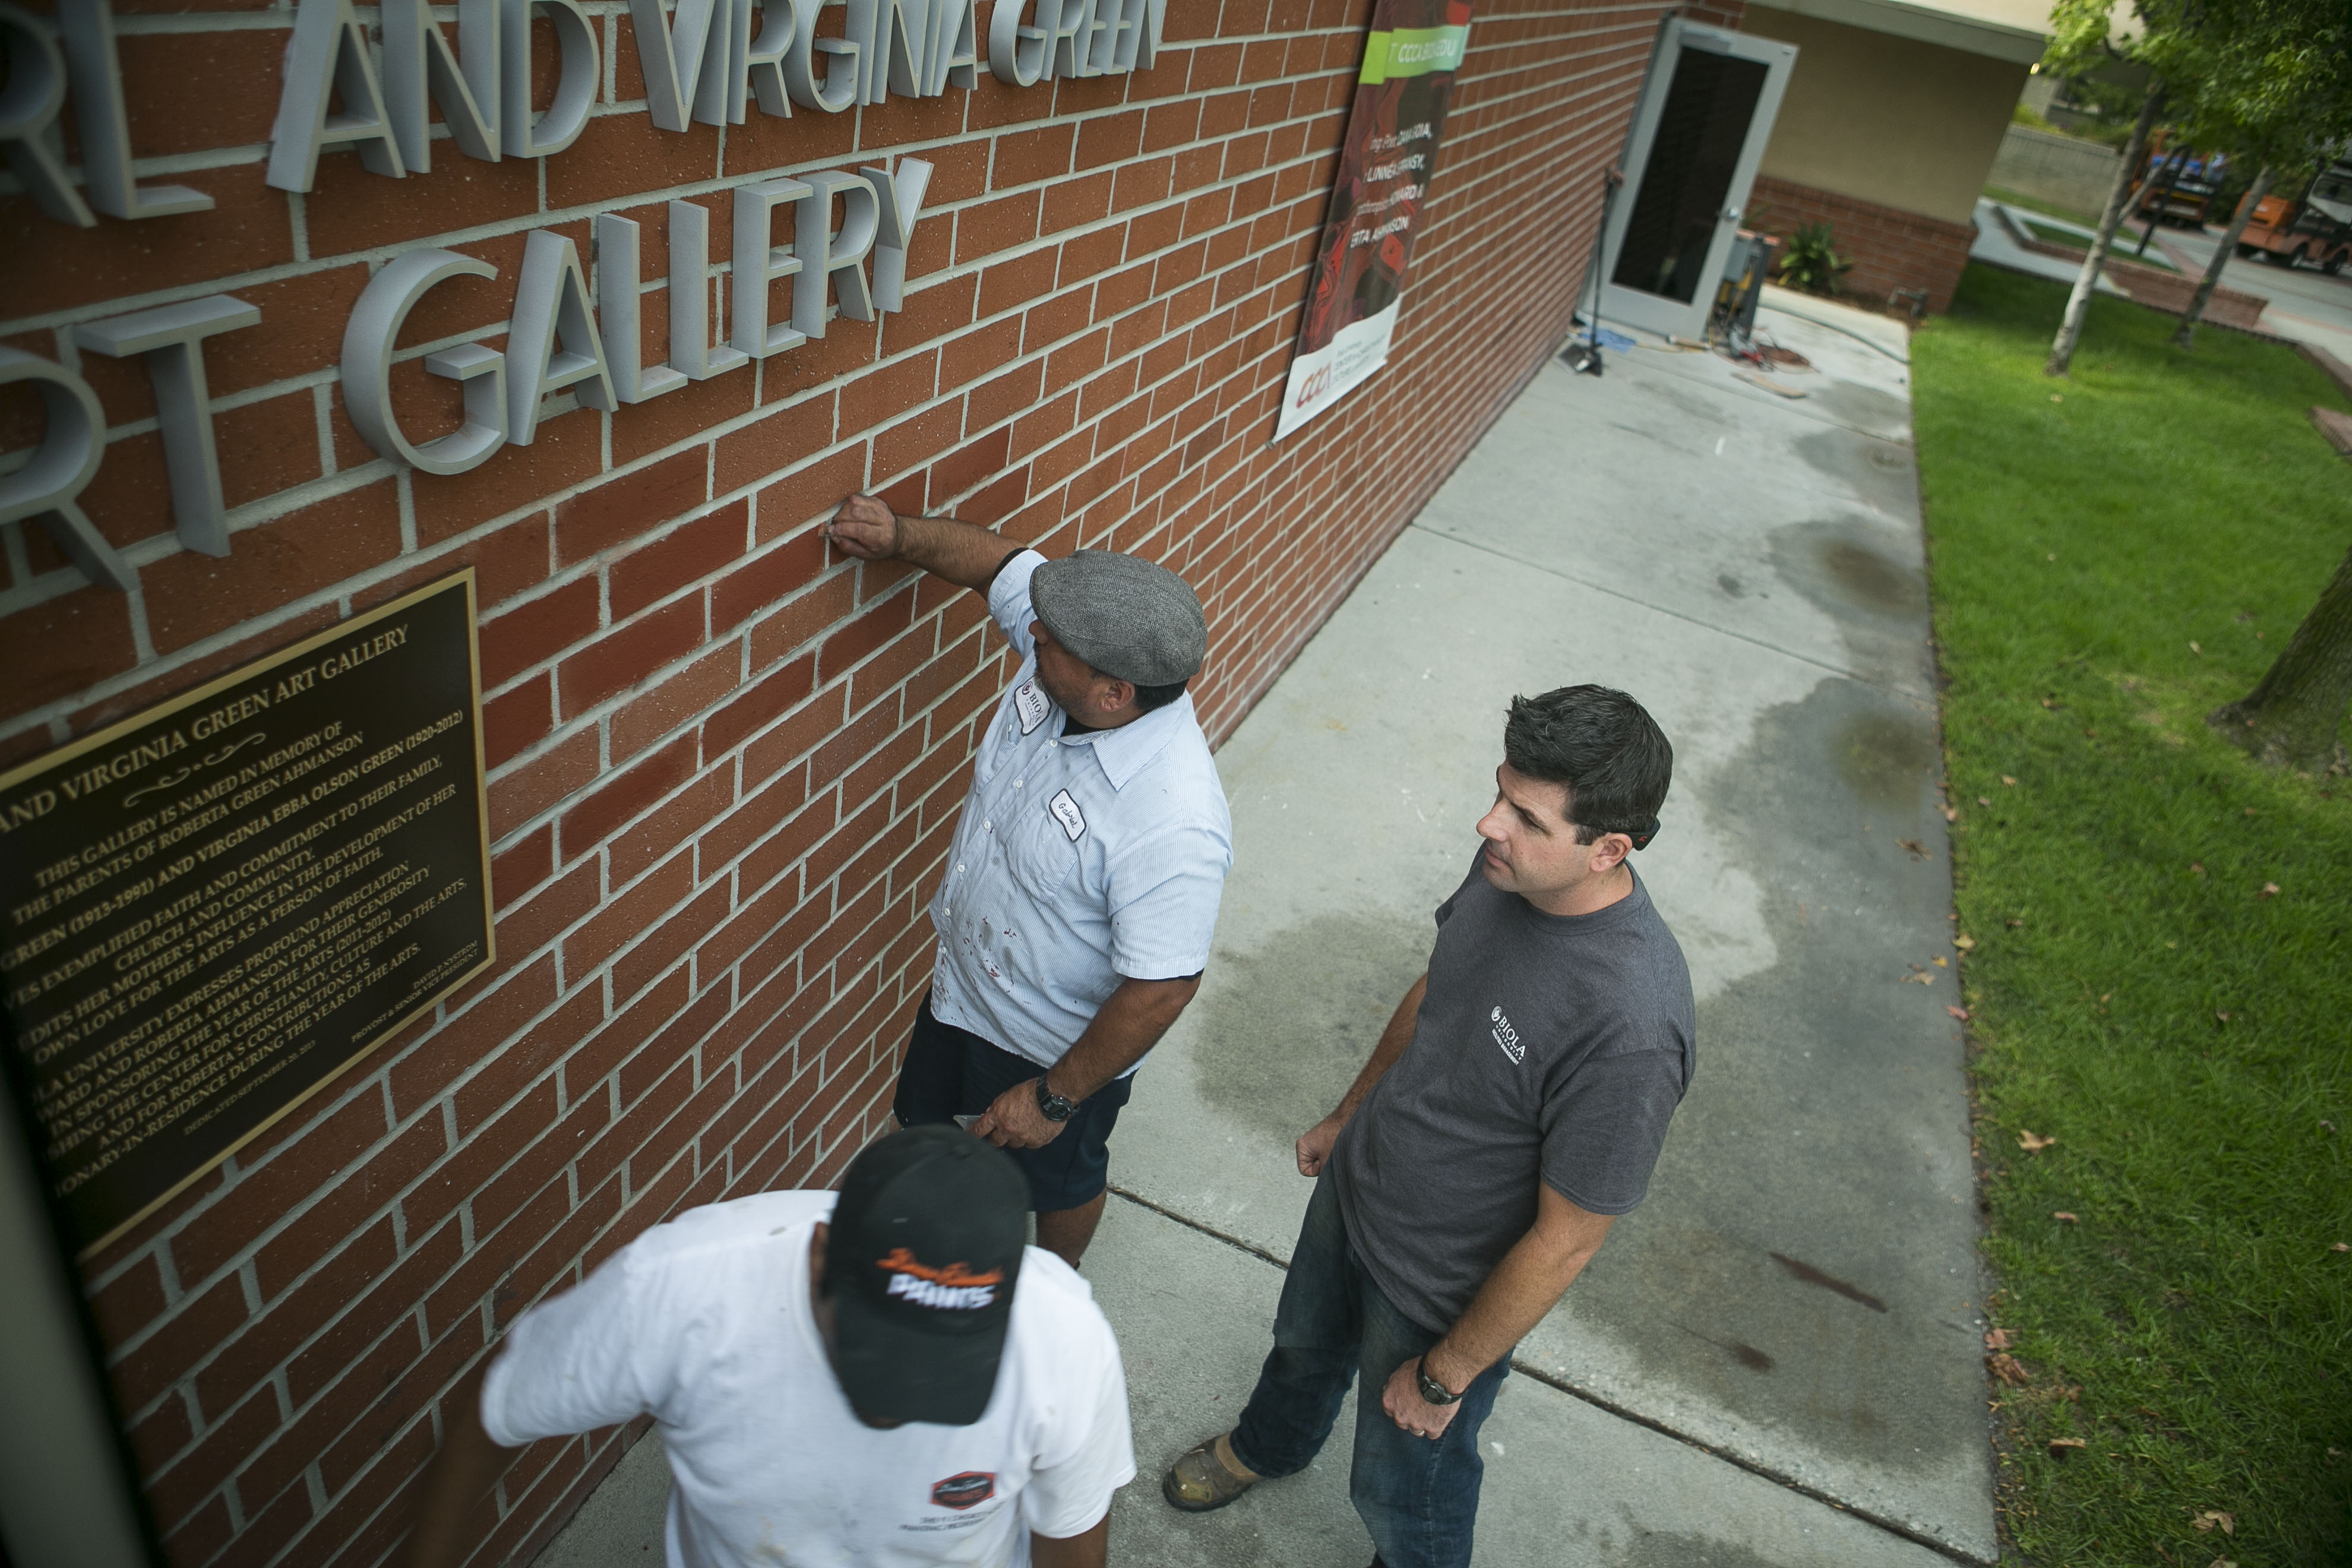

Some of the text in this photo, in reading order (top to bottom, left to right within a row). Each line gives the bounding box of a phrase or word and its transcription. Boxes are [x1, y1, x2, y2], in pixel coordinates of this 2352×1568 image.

[265, 0, 599, 193] AND
[629, 0, 978, 132] VIRGINIA
[988, 0, 1164, 87] GREEN
[342, 157, 934, 475] GALLERY
[0, 624, 407, 832] AND VIRGINIA GREEN ART GALLERY
[13, 731, 363, 924] THE PARENTS OF ROBERTA GREEN AHMANSON
[36, 721, 342, 887] THIS GALLERY IS NAMED IN MEMORY OF
[0, 710, 463, 972] GREEN (1913-1991) AND VIRGINIA EBBA OLSON GREEN (1920-2012)
[43, 919, 151, 990] EXEMPLIFIED
[154, 890, 201, 927] FAITH
[206, 871, 238, 899] AND
[240, 813, 337, 877] COMMITMENT
[339, 802, 358, 821] TO
[359, 780, 397, 810] THEIR
[398, 755, 442, 788] FAMILY,
[76, 989, 111, 1017] HER
[113, 938, 194, 994] MOTHER'S
[197, 890, 276, 946] INFLUENCE
[277, 879, 293, 898] IN
[295, 862, 323, 886] THE
[324, 807, 414, 870] DEVELOPMENT
[416, 798, 431, 815] OF
[433, 783, 456, 805] HER
[116, 848, 315, 970] CHURCH AND COMMUNITY.
[33, 861, 409, 1105] LA UNIVERSITY EXPRESSES PROFOUND APPRECIATION
[36, 846, 384, 1061] OWN LOVE FOR THE ARTS AS A PERSON OF FAITH.
[52, 909, 391, 1136] IN SPONSORING THE YEAR OF THE ARTS (2011-2012)
[97, 1057, 132, 1088] AND
[134, 1013, 203, 1062] ROBERTA
[207, 956, 288, 1017] AHMANSON
[290, 938, 317, 963] FOR
[318, 913, 356, 944] THEIR
[358, 868, 429, 919] GENEROSITY
[101, 957, 370, 1148] AND FOR ROBERTA'S CONTRIBUTIONS AS
[108, 1092, 140, 1120] THE
[142, 1053, 201, 1098] CENTER
[202, 1033, 232, 1060] FOR
[233, 969, 329, 1038] CHRISTIANITY,
[330, 931, 384, 973] CULTURE
[386, 913, 412, 938] AND
[413, 896, 435, 918] THE
[438, 878, 467, 904] ARTS,
[229, 1035, 284, 1079] DURING
[286, 1016, 312, 1040] THE
[312, 993, 346, 1021] YEAR
[347, 980, 362, 998] OF
[364, 963, 388, 986] THE
[390, 943, 421, 970] ARTS.
[1499, 1015, 1526, 1057] BIOLA
